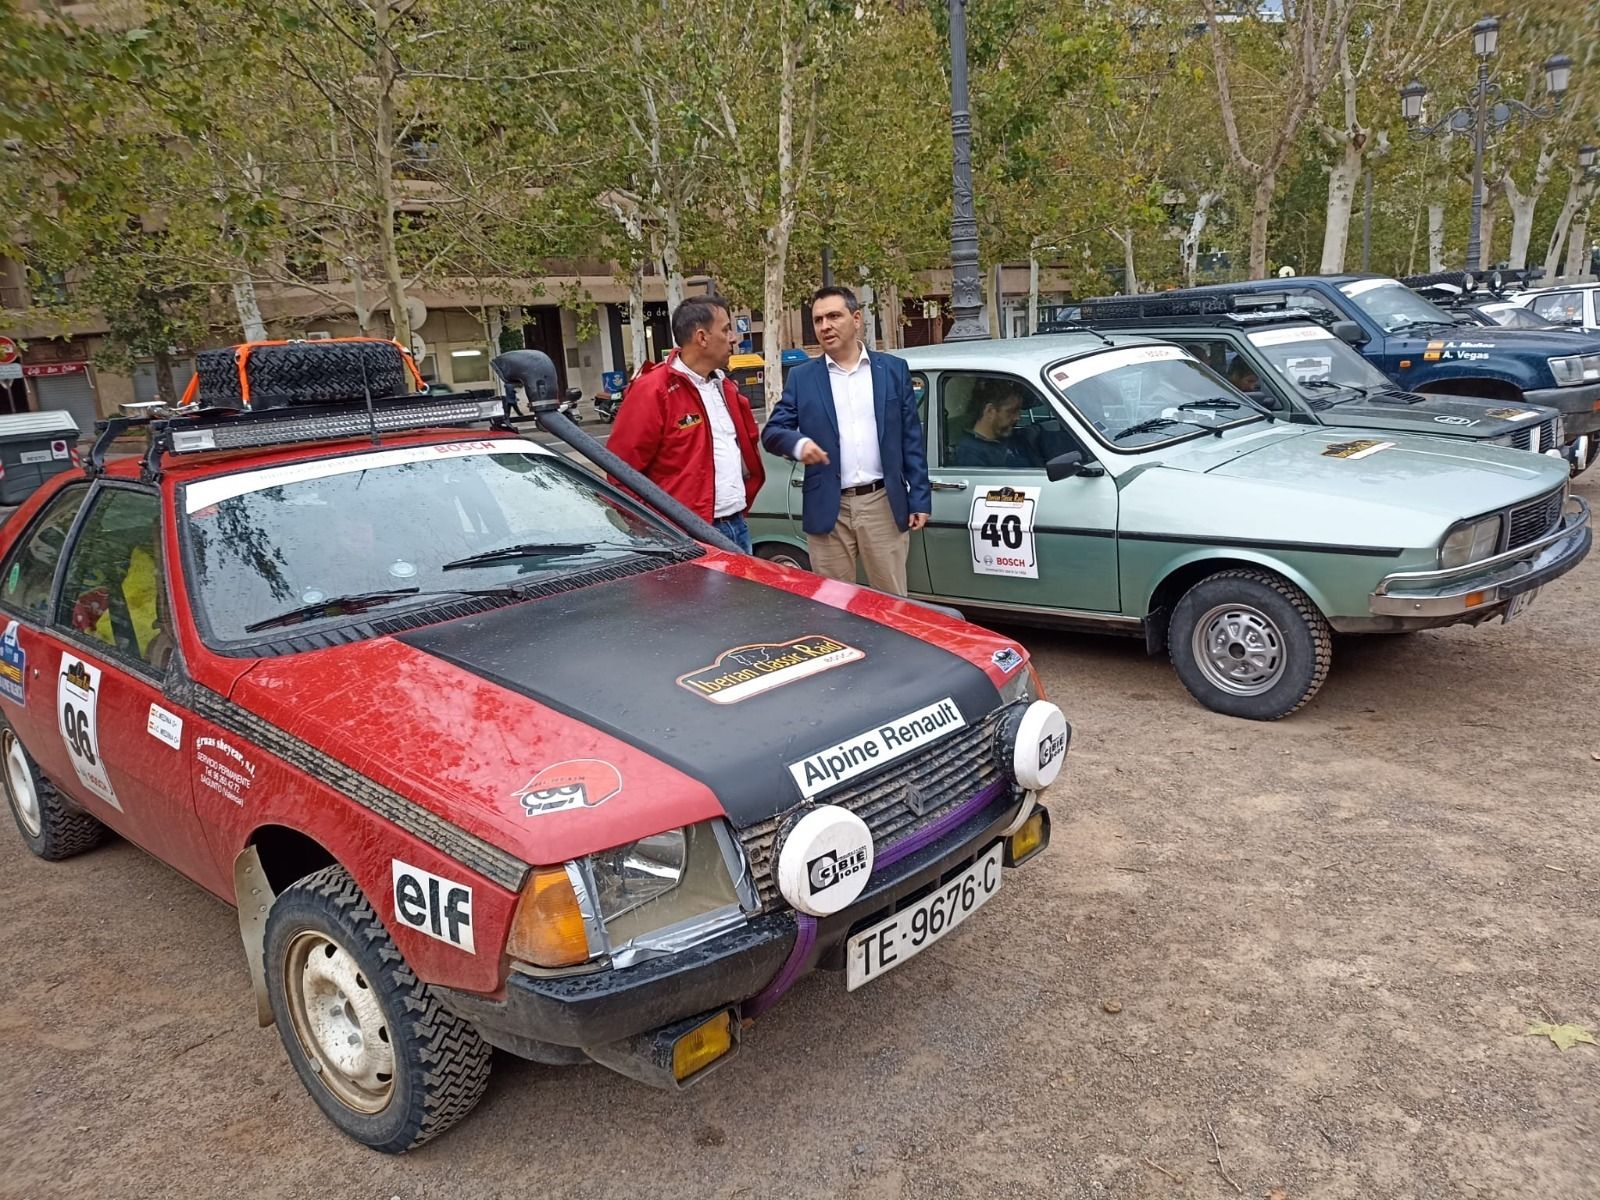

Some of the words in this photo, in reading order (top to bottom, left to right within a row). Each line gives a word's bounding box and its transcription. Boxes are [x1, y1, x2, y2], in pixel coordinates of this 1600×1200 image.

[1442, 350, 1454, 359] A.
[1456, 350, 1490, 361] Vegas
[434, 441, 497, 454] BOSCH
[980, 514, 1023, 550] 40
[996, 556, 1026, 568] BOSCH
[687, 668, 760, 694] Iberian
[752, 652, 809, 673] Classic
[792, 640, 842, 657] Raid
[64, 702, 96, 766] 96
[802, 739, 880, 787] Alpine
[878, 702, 958, 751] Renault
[820, 850, 866, 879] CIBIE
[840, 861, 867, 880] IODE
[395, 873, 470, 944] elf
